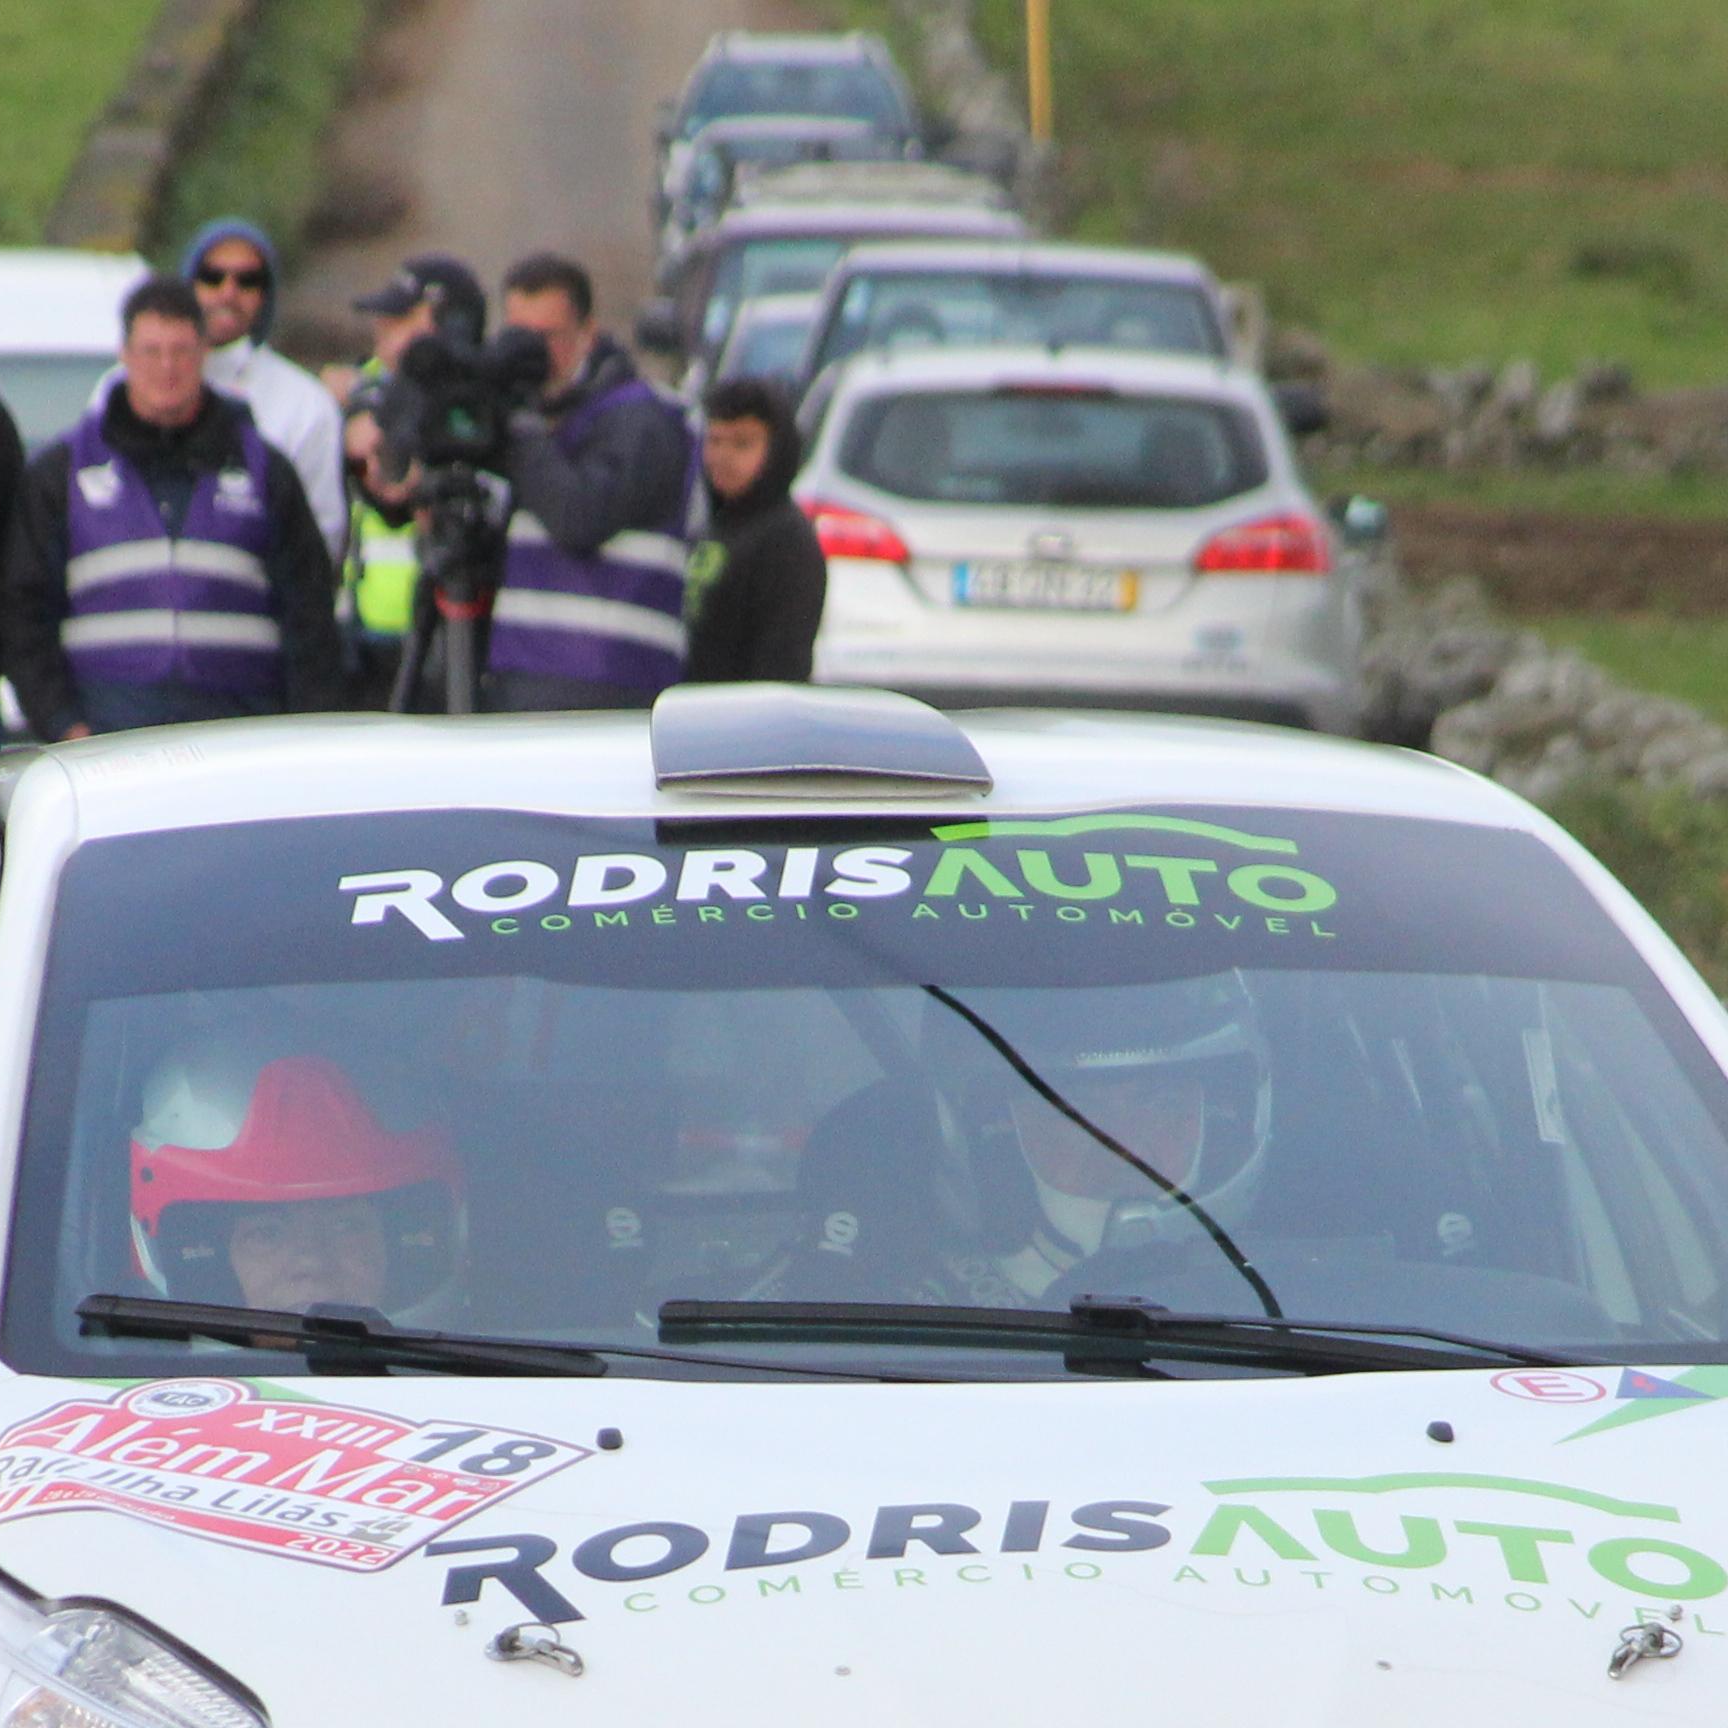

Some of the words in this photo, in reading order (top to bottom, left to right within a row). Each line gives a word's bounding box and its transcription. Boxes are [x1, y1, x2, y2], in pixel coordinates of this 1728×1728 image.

[338, 845, 1337, 941] RODRISAUTO
[490, 899, 862, 935] COMÉRCIO
[911, 900, 1336, 939] AUTOMÓVEL
[232, 1408, 395, 1449] XXIII
[409, 1428, 558, 1477] 18
[1, 1413, 271, 1481] Além
[265, 1449, 488, 1521] Mar
[210, 1488, 349, 1528] Lilás
[285, 1534, 392, 1565] 2022
[424, 1497, 1728, 1622] RODRISAUTO
[623, 1561, 1104, 1613] COMÉRCIO
